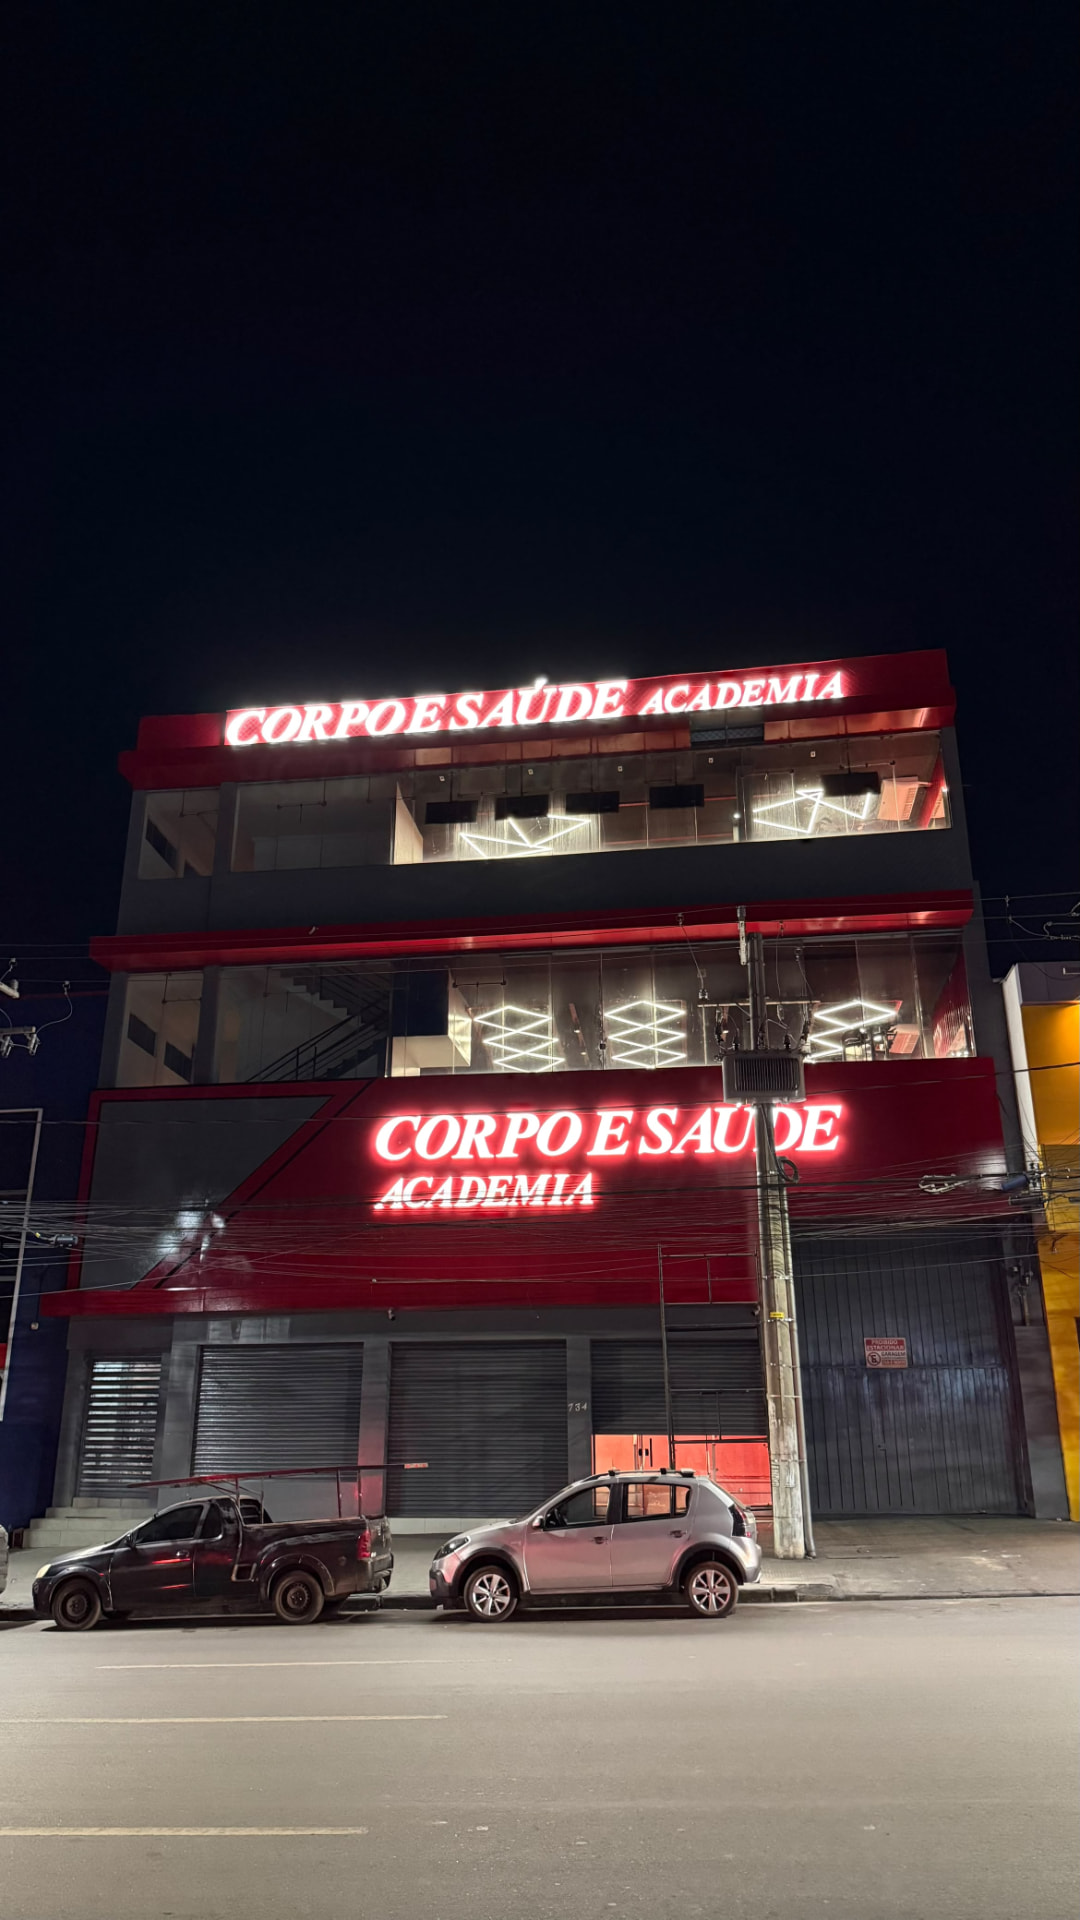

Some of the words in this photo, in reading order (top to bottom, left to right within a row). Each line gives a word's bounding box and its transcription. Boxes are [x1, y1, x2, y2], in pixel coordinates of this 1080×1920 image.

[226, 698, 405, 746] CORPO
[404, 696, 447, 734] E
[448, 677, 629, 730] SAÚDE
[637, 671, 843, 715] ACADEMIA
[375, 1111, 583, 1161] CORPO
[586, 1110, 634, 1156] E
[373, 1173, 594, 1210] ACADEMIA
[568, 1402, 587, 1412] 734
